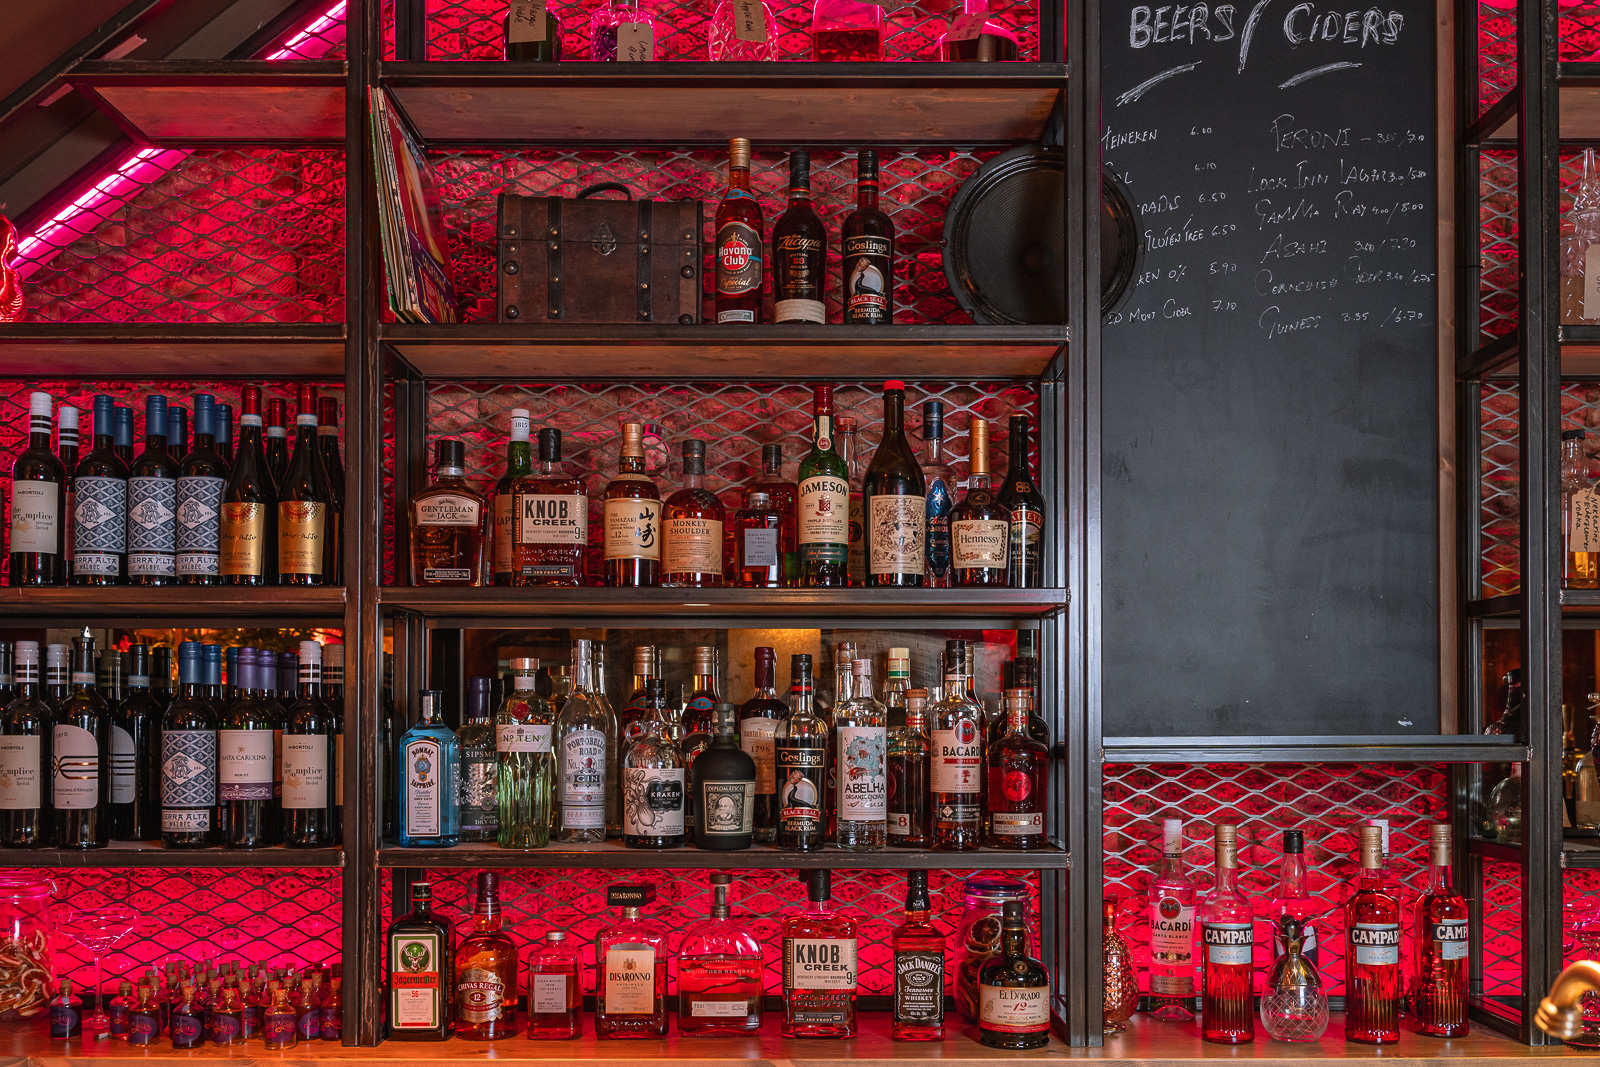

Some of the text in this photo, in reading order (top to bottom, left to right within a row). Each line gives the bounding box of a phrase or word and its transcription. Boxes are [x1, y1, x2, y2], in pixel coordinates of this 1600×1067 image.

[1283, 3, 1404, 49] CIDERS
[1270, 114, 1351, 152] PERONI
[779, 235, 822, 251] Zacapa
[847, 240, 887, 254] Goslings
[718, 246, 753, 257] Havana
[723, 255, 745, 266] Club
[793, 256, 805, 265] 23
[850, 295, 869, 305] BLACK
[800, 481, 848, 498] JAMESON
[421, 505, 474, 513] GENTLEMAN
[525, 499, 568, 519] KNOB
[437, 512, 459, 520] JACK
[672, 520, 707, 528] MONKEY
[574, 526, 581, 540] 9
[614, 531, 622, 539] 12
[669, 527, 711, 535] SHOULDER
[960, 534, 1000, 546] Hennessy
[95, 556, 118, 565] ALTA
[177, 556, 219, 565] ERRA ALTA
[516, 734, 540, 743] TEN
[411, 747, 435, 756] BOMBAY
[579, 747, 598, 756] ROAD
[750, 745, 771, 753] 1796
[780, 751, 821, 766] Goslings
[410, 778, 436, 789] SAPPHIRE
[576, 775, 599, 783] GIN
[844, 782, 886, 794] ABELHA
[185, 813, 208, 821] ALTA
[783, 808, 802, 816] BLACK
[897, 816, 908, 827] 8
[1032, 815, 1042, 826] 8
[610, 892, 642, 900] DISARONNO
[1150, 919, 1192, 932] BACARDÍ
[1351, 929, 1400, 945] CAMPAR
[1436, 925, 1469, 940] CAMP
[795, 943, 840, 964] KNOB
[898, 957, 941, 975] JACK DANIEL'S
[609, 972, 651, 982] DISARONNO
[846, 971, 853, 985] 9
[457, 982, 502, 993] CHIVAS REGAL
[904, 985, 934, 993] Tennessee
[411, 990, 420, 998] 56
[473, 993, 482, 1001] 12
[999, 989, 1041, 1001] EL DORADO
[1012, 1002, 1028, 1012] 12
